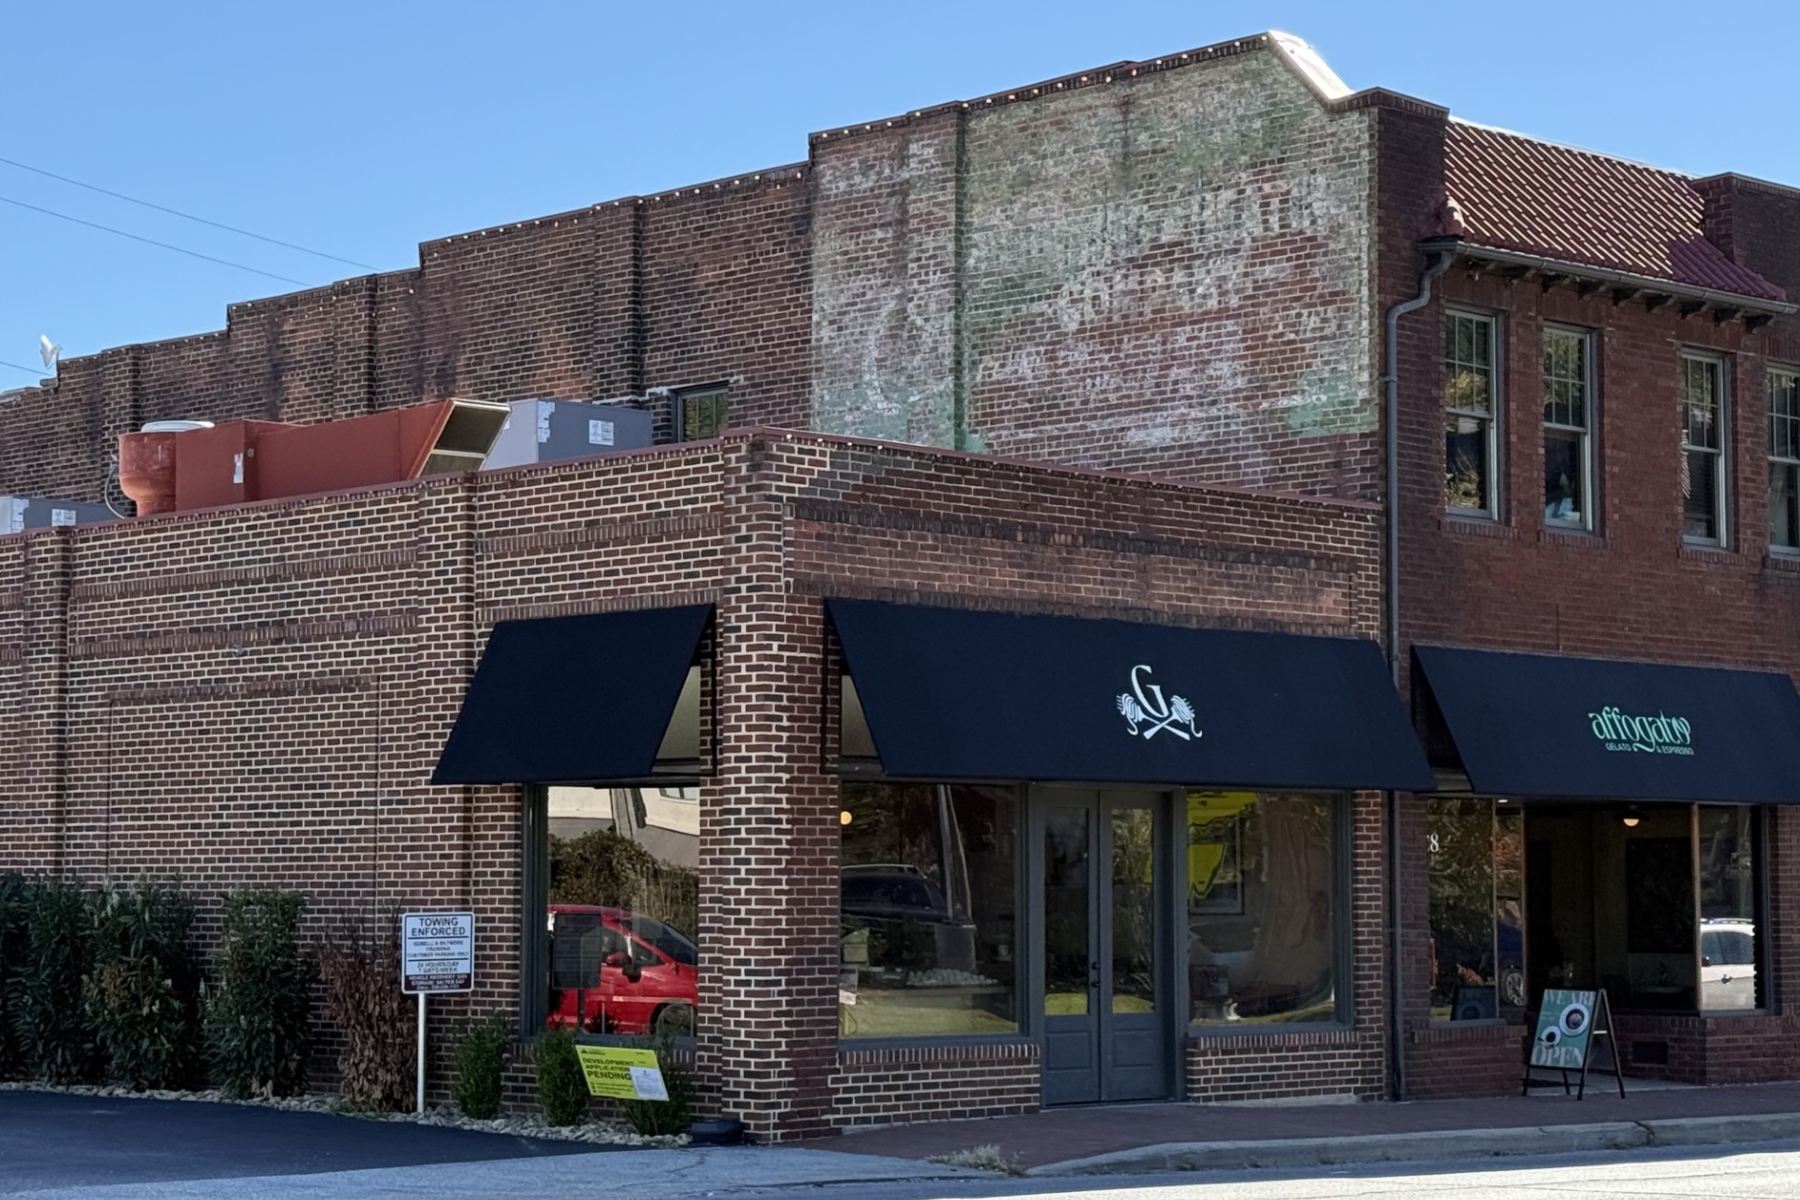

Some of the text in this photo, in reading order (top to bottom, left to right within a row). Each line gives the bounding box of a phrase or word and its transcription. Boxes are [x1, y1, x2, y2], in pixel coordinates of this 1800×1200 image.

[1605, 742, 1632, 751] GELATO
[1662, 745, 1694, 755] ESPRESSO
[419, 917, 458, 926] TOWING
[411, 927, 466, 936] ENFORCED
[583, 1057, 634, 1066] DEVELOPMENT
[1530, 1045, 1584, 1069] OPEN
[586, 1064, 631, 1072] APPLICATION
[587, 1070, 632, 1080] PENDING
